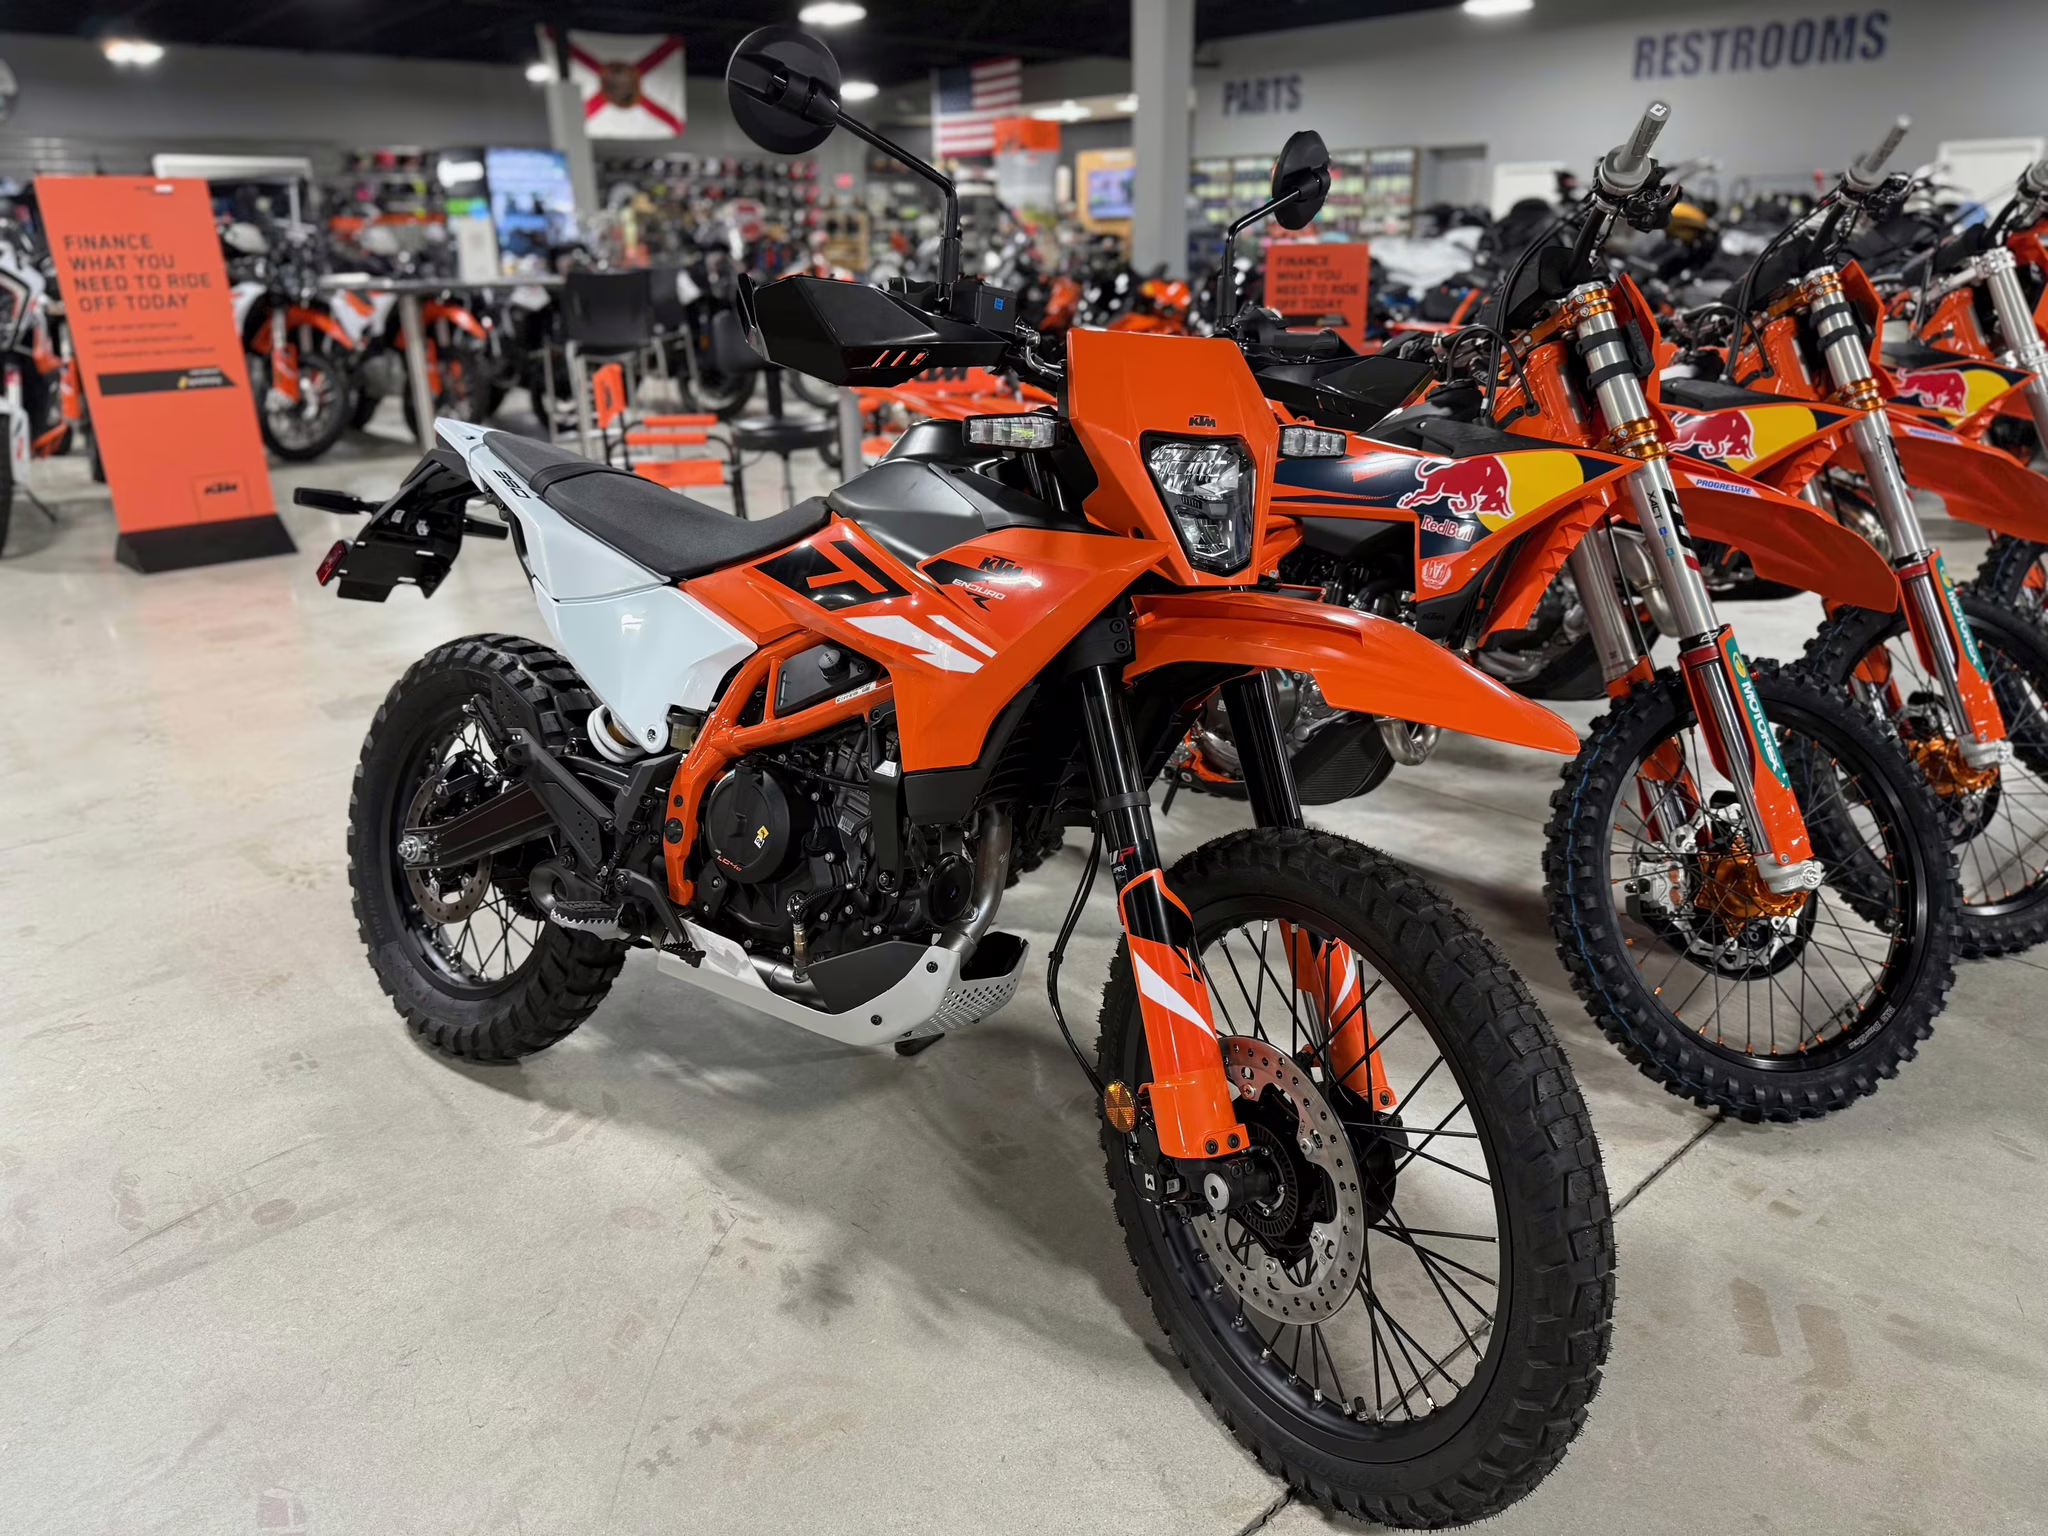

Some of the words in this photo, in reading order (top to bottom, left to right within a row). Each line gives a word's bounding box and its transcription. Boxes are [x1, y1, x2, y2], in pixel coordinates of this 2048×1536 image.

[1633, 9, 1890, 81] RESTROOMS
[1222, 75, 1301, 117] PARTS
[64, 234, 153, 250] FINANCE
[70, 255, 126, 271] WHAT
[136, 254, 176, 269] YOU
[1277, 256, 1329, 267] FINANCE
[73, 275, 129, 292] NEED
[134, 274, 161, 289] TO
[168, 273, 211, 288] RIDE
[79, 296, 118, 313] OFF
[125, 294, 190, 311] TODAY
[1188, 414, 1216, 427] KTM
[204, 482, 238, 496] KTM
[492, 469, 531, 499] 390
[1695, 479, 1752, 495] PROGRESSIVE
[1646, 490, 1664, 519] XACT
[1421, 515, 1450, 535] Red
[1447, 521, 1476, 542] Bull
[977, 555, 1024, 577] KTM
[952, 578, 1006, 600] ENDURO
[1947, 591, 1979, 665] MOTOREX
[1741, 681, 1780, 772] MOTOREX
